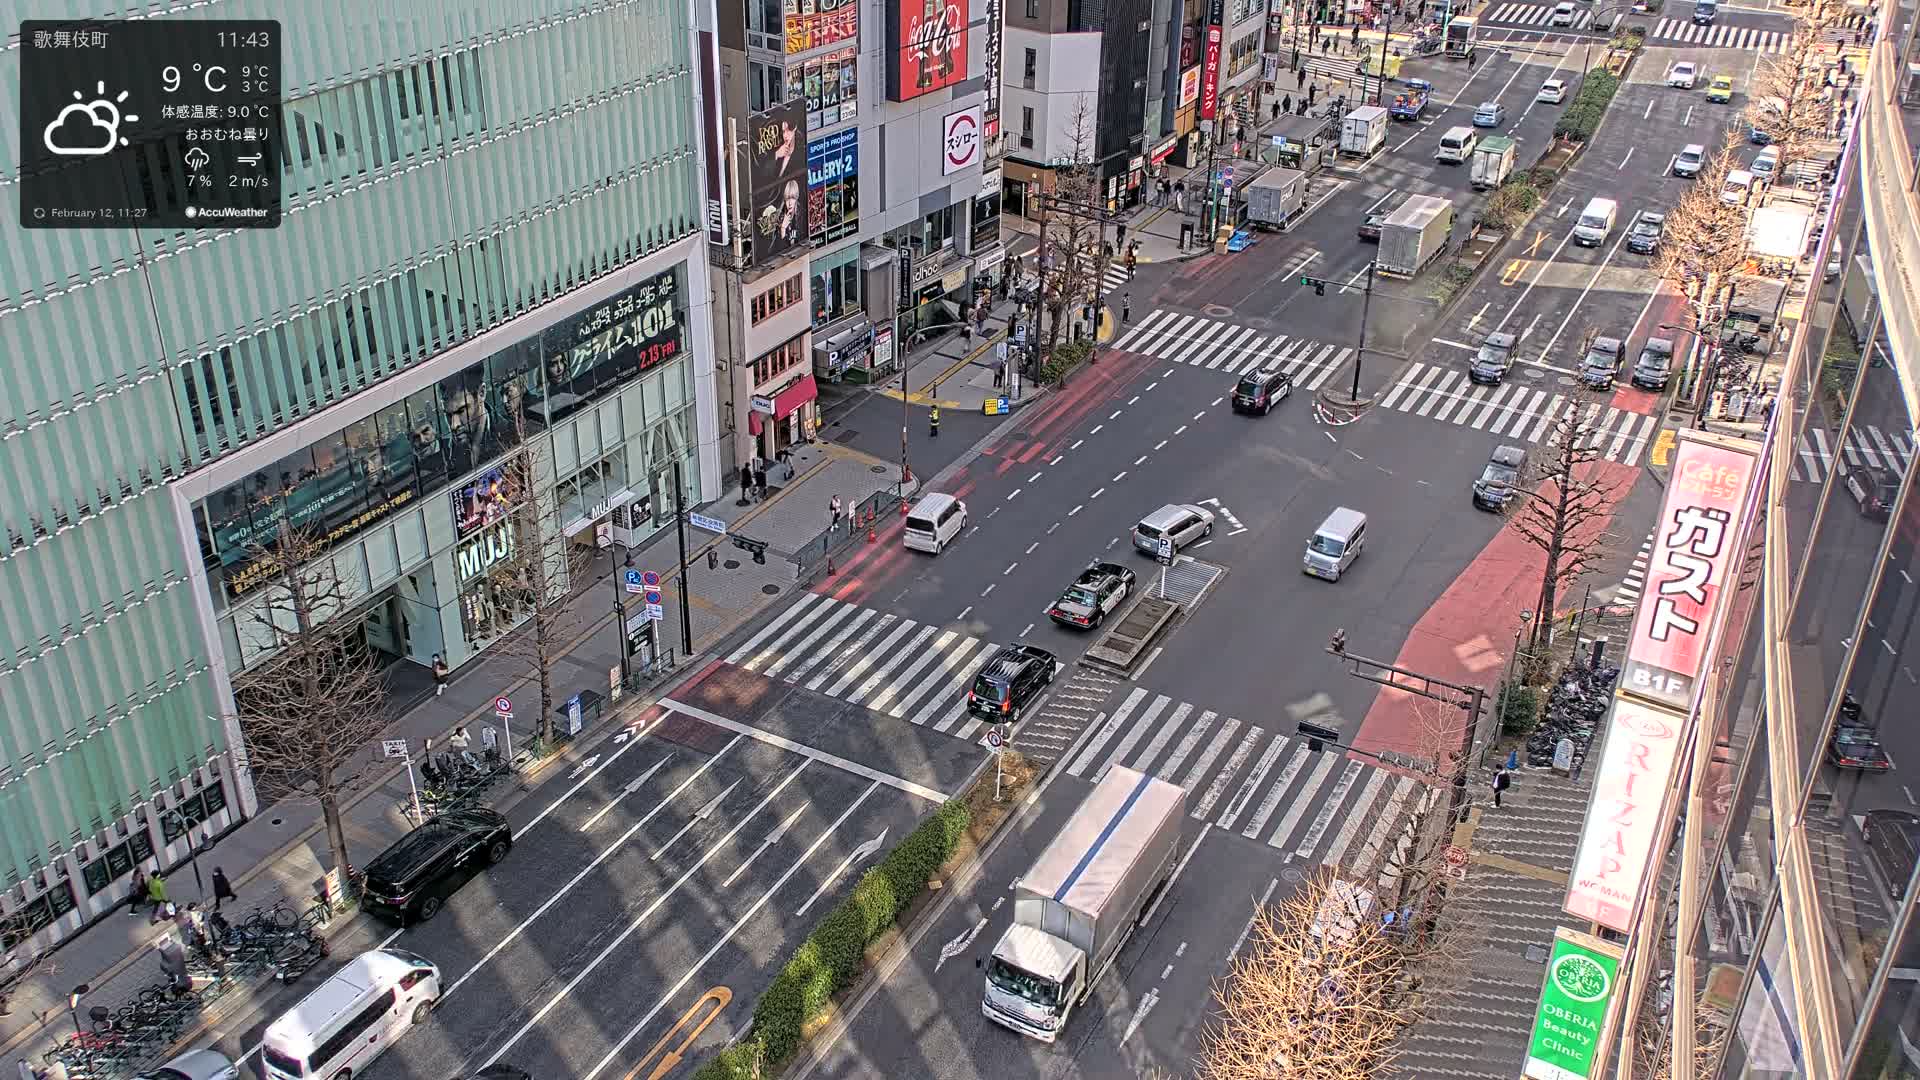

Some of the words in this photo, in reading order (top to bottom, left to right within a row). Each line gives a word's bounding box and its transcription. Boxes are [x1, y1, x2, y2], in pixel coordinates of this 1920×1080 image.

[1204, 45, 1219, 110] バーガーキング
[947, 130, 978, 149] スシロー
[808, 154, 853, 187] ALLERY-2
[709, 198, 722, 233] MUJI
[639, 343, 660, 369] 2.13
[662, 341, 676, 358] FRI
[1682, 459, 1739, 487] Café
[592, 496, 613, 519] MUJI
[458, 522, 515, 581] MUJI
[1649, 505, 1731, 642] ガスト
[1632, 667, 1684, 697] B1F
[1598, 743, 1652, 880] RIZAP
[1559, 969, 1601, 991] OBERIA
[1543, 1003, 1598, 1032] OBERIA
[1543, 1018, 1592, 1046] Beauty
[1542, 1037, 1584, 1061] Clinic
